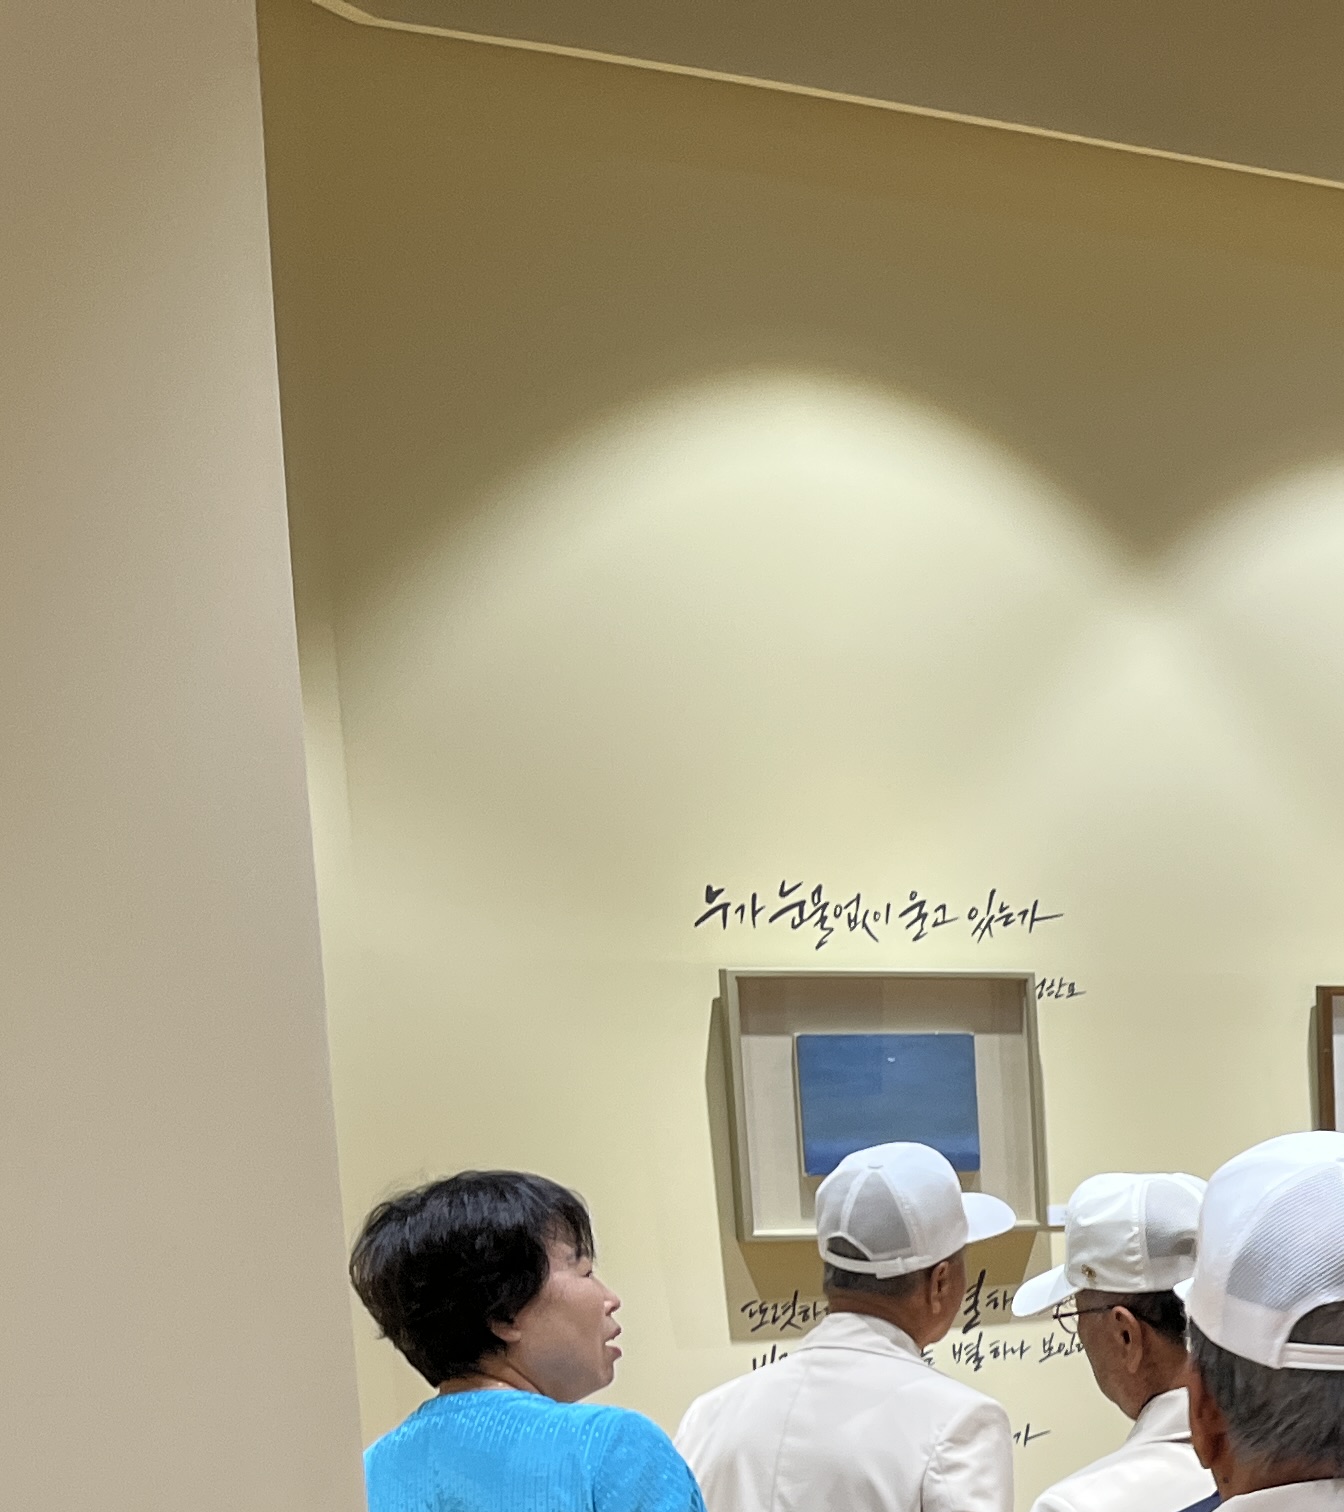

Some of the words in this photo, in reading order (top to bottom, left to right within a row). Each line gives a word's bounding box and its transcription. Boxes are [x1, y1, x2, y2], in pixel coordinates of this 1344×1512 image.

[693, 883, 766, 930] 누가
[898, 890, 960, 942] 울고
[967, 888, 1064, 943] 있는가
[741, 1290, 830, 1332] 또렷하
